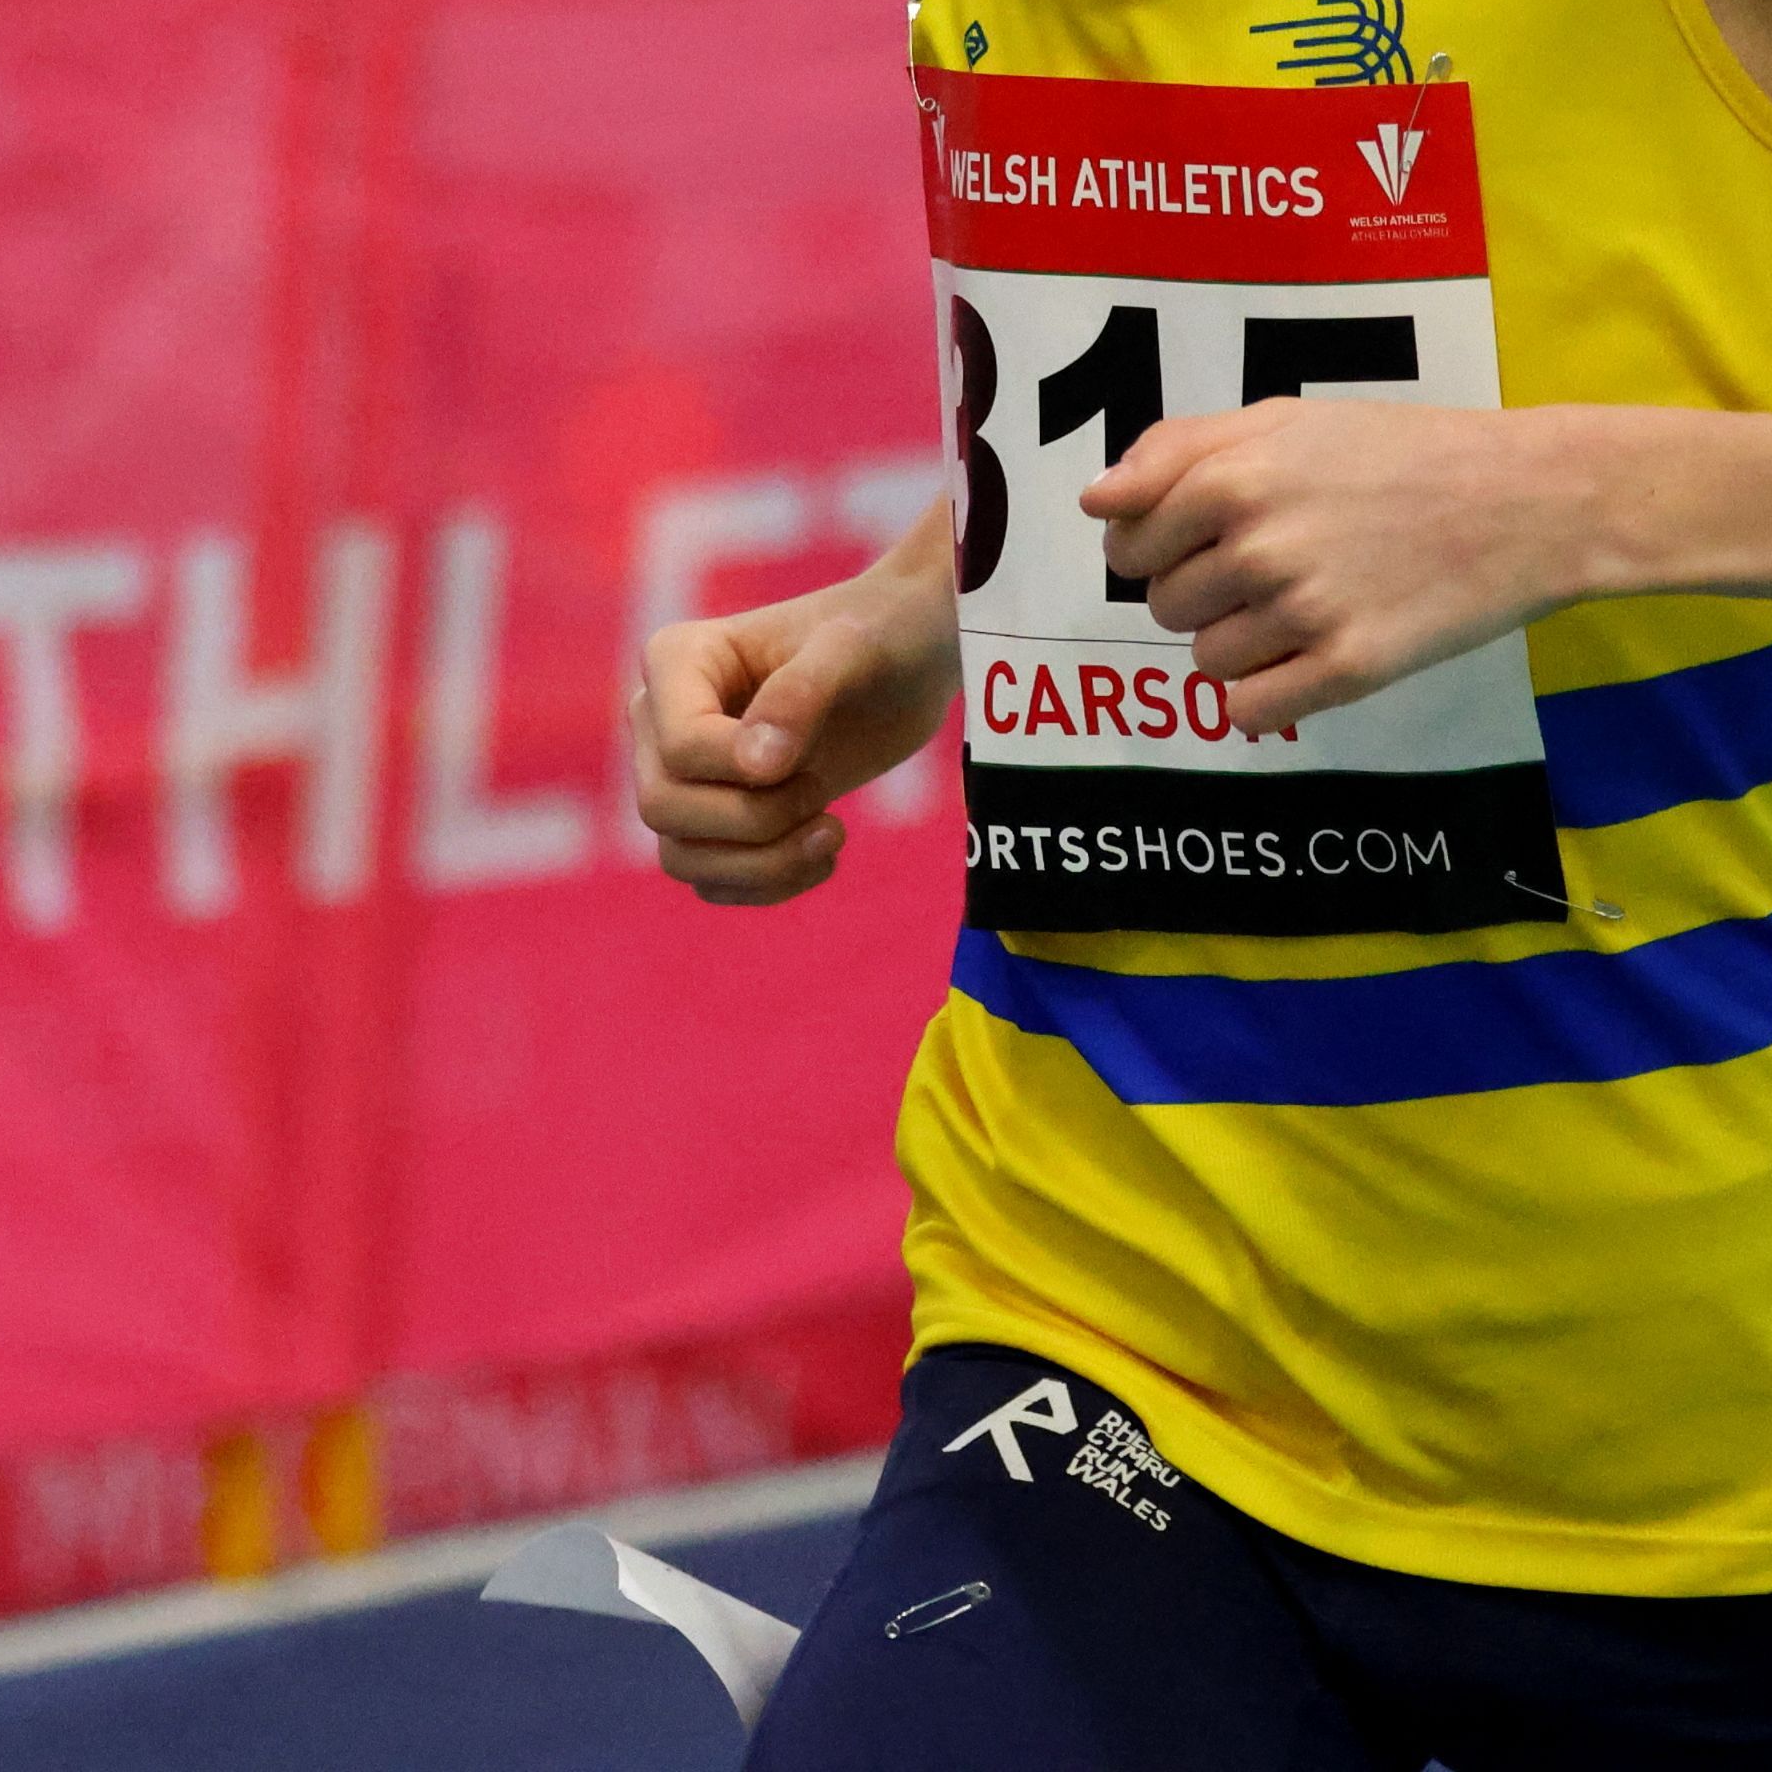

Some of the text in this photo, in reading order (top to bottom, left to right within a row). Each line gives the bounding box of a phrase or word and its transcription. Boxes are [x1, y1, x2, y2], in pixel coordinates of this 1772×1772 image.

[950, 148, 1325, 218] WELSH ATHLETICS
[1349, 213, 1448, 228] WELSH ATHLETICS
[983, 659, 1299, 743] CARSO
[1075, 1443, 1140, 1485] RUN
[1086, 1427, 1181, 1488] CYMRU
[1065, 1457, 1172, 1532] WALES
